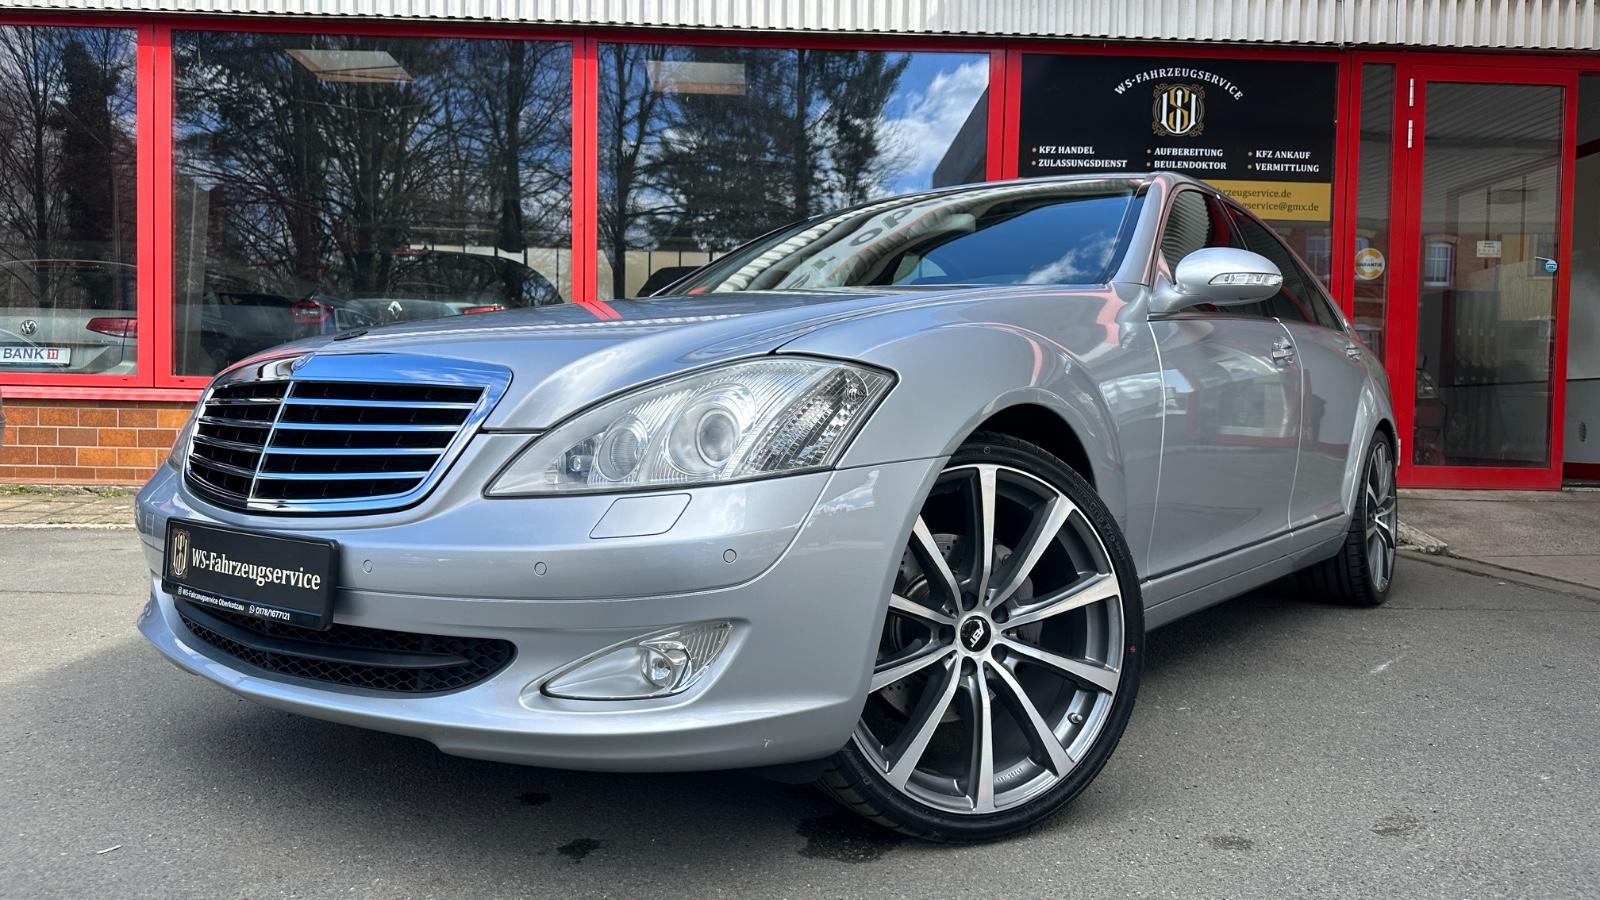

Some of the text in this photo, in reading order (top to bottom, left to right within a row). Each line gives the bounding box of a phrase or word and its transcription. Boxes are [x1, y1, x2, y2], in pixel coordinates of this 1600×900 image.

[1114, 67, 1244, 101] WS-FAHRZEUGSERVICE
[1039, 146, 1095, 155] KFZ HANDEL
[1154, 148, 1223, 157] AUFBEREITUNG
[1255, 150, 1311, 159] KFZ ANKAUF
[1038, 159, 1128, 168] ZULASSUNGSDIENST
[1154, 160, 1227, 170] BEULENDOKTOR
[1255, 163, 1319, 173] VERMITTLUNG
[3, 348, 44, 359] BANK
[192, 547, 321, 590] WS-Fahrzeugservice
